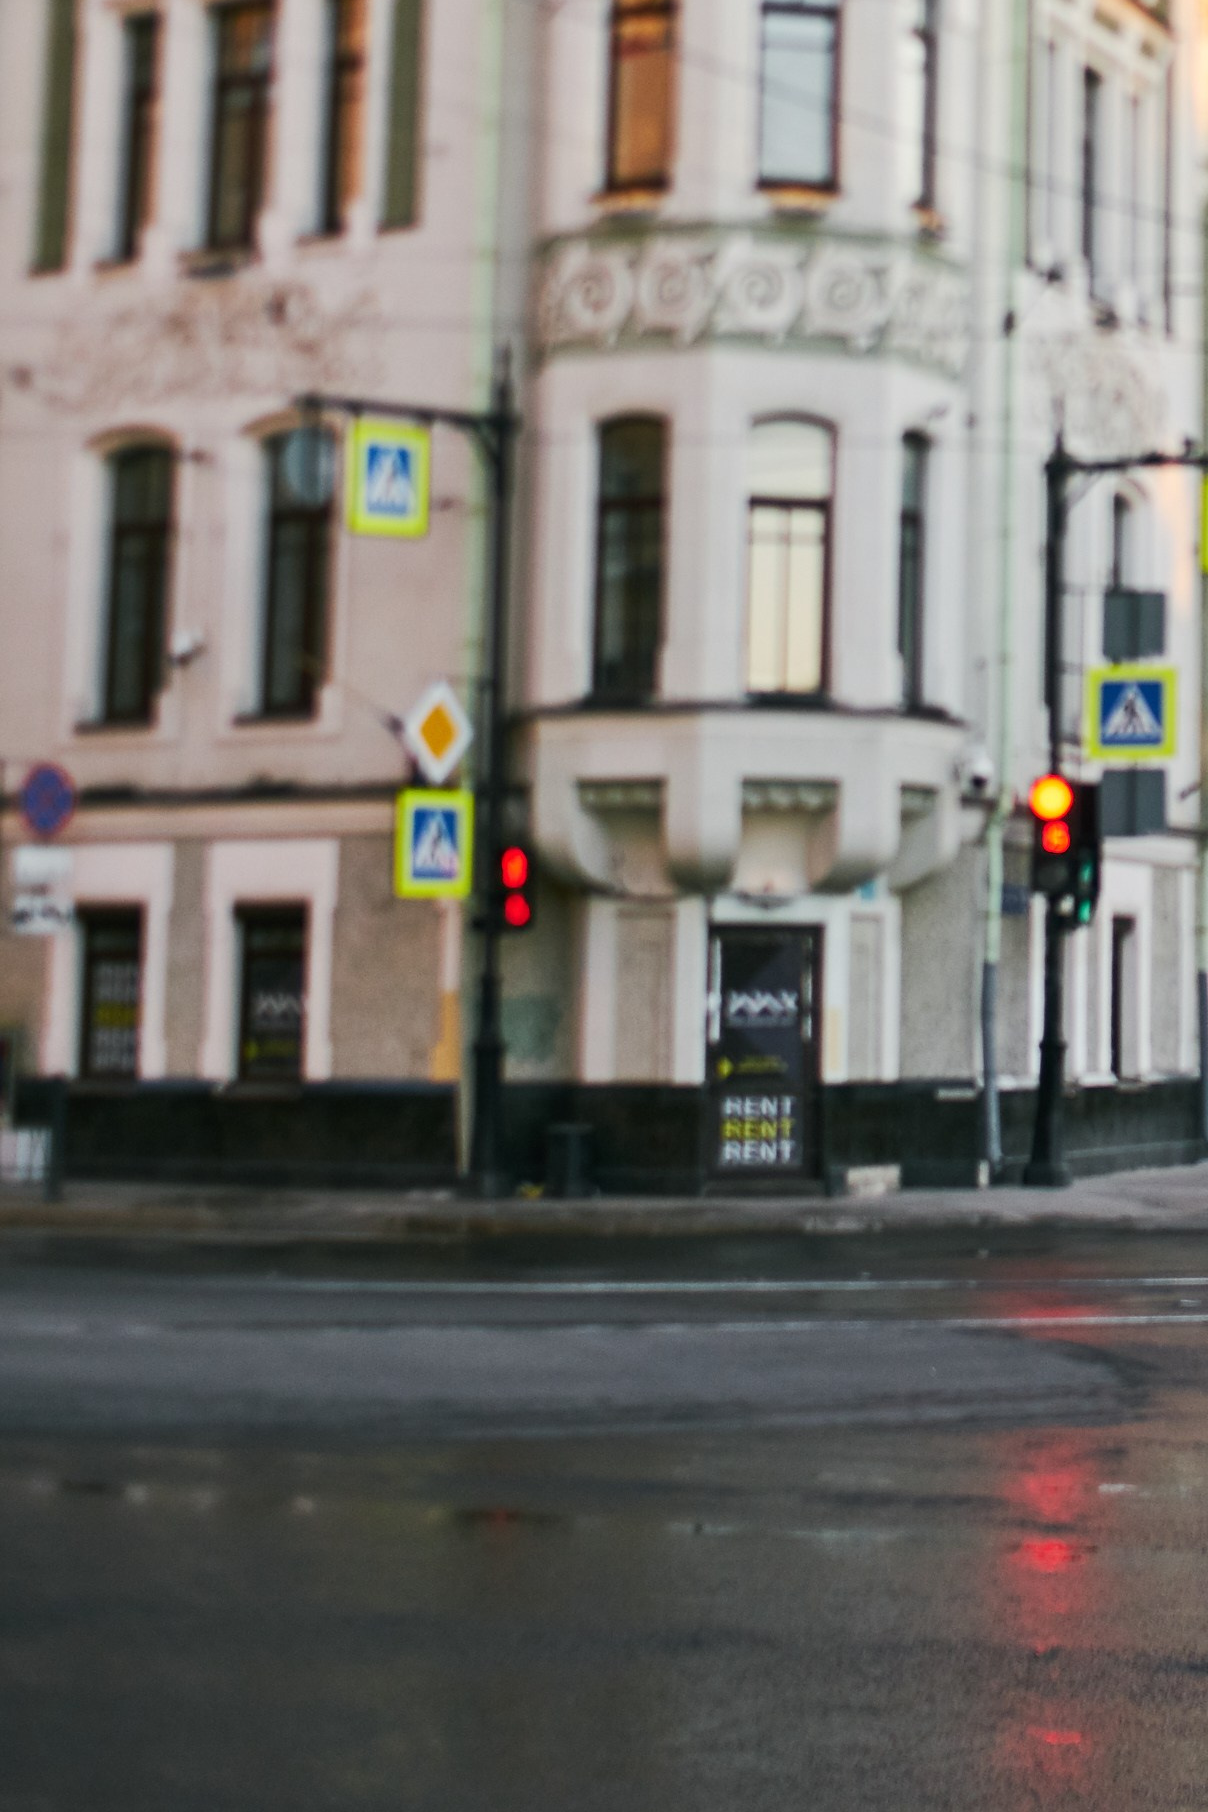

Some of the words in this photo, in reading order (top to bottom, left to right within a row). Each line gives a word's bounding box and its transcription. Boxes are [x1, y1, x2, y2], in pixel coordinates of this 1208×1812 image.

[723, 1096, 796, 1116] RENT
[722, 1118, 796, 1139] RENT
[722, 1141, 796, 1162] RENT
